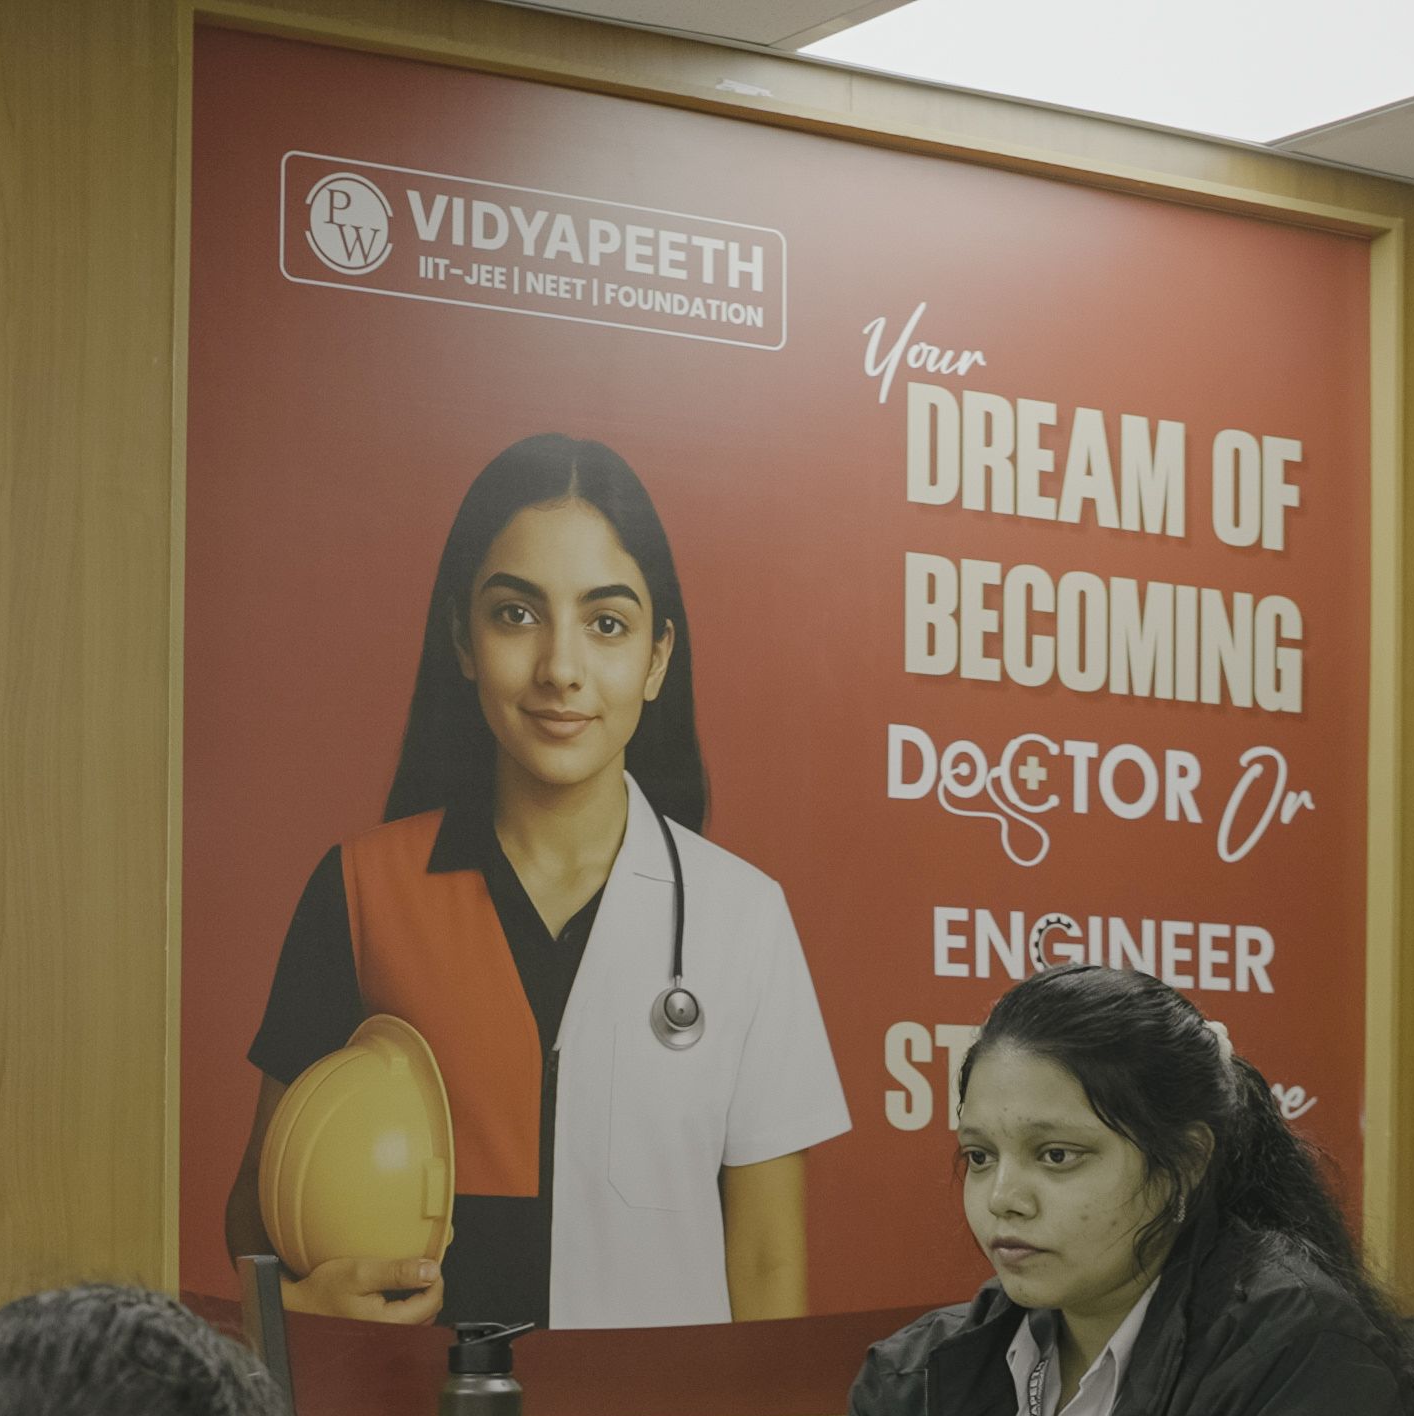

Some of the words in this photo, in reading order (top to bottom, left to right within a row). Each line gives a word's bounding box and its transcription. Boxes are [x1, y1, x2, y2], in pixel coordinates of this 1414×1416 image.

[406, 190, 764, 293] VIDYAPEETH
[418, 256, 507, 290] IIT-JEE
[525, 272, 586, 301] NEET
[604, 282, 764, 329] FOUNDATION
[862, 301, 987, 404] Your
[907, 381, 1186, 538] DREAM
[1212, 428, 1303, 552] OF
[904, 551, 1303, 714] BECOMING
[1216, 745, 1316, 864] Or
[933, 906, 1276, 994] ENGINEER
